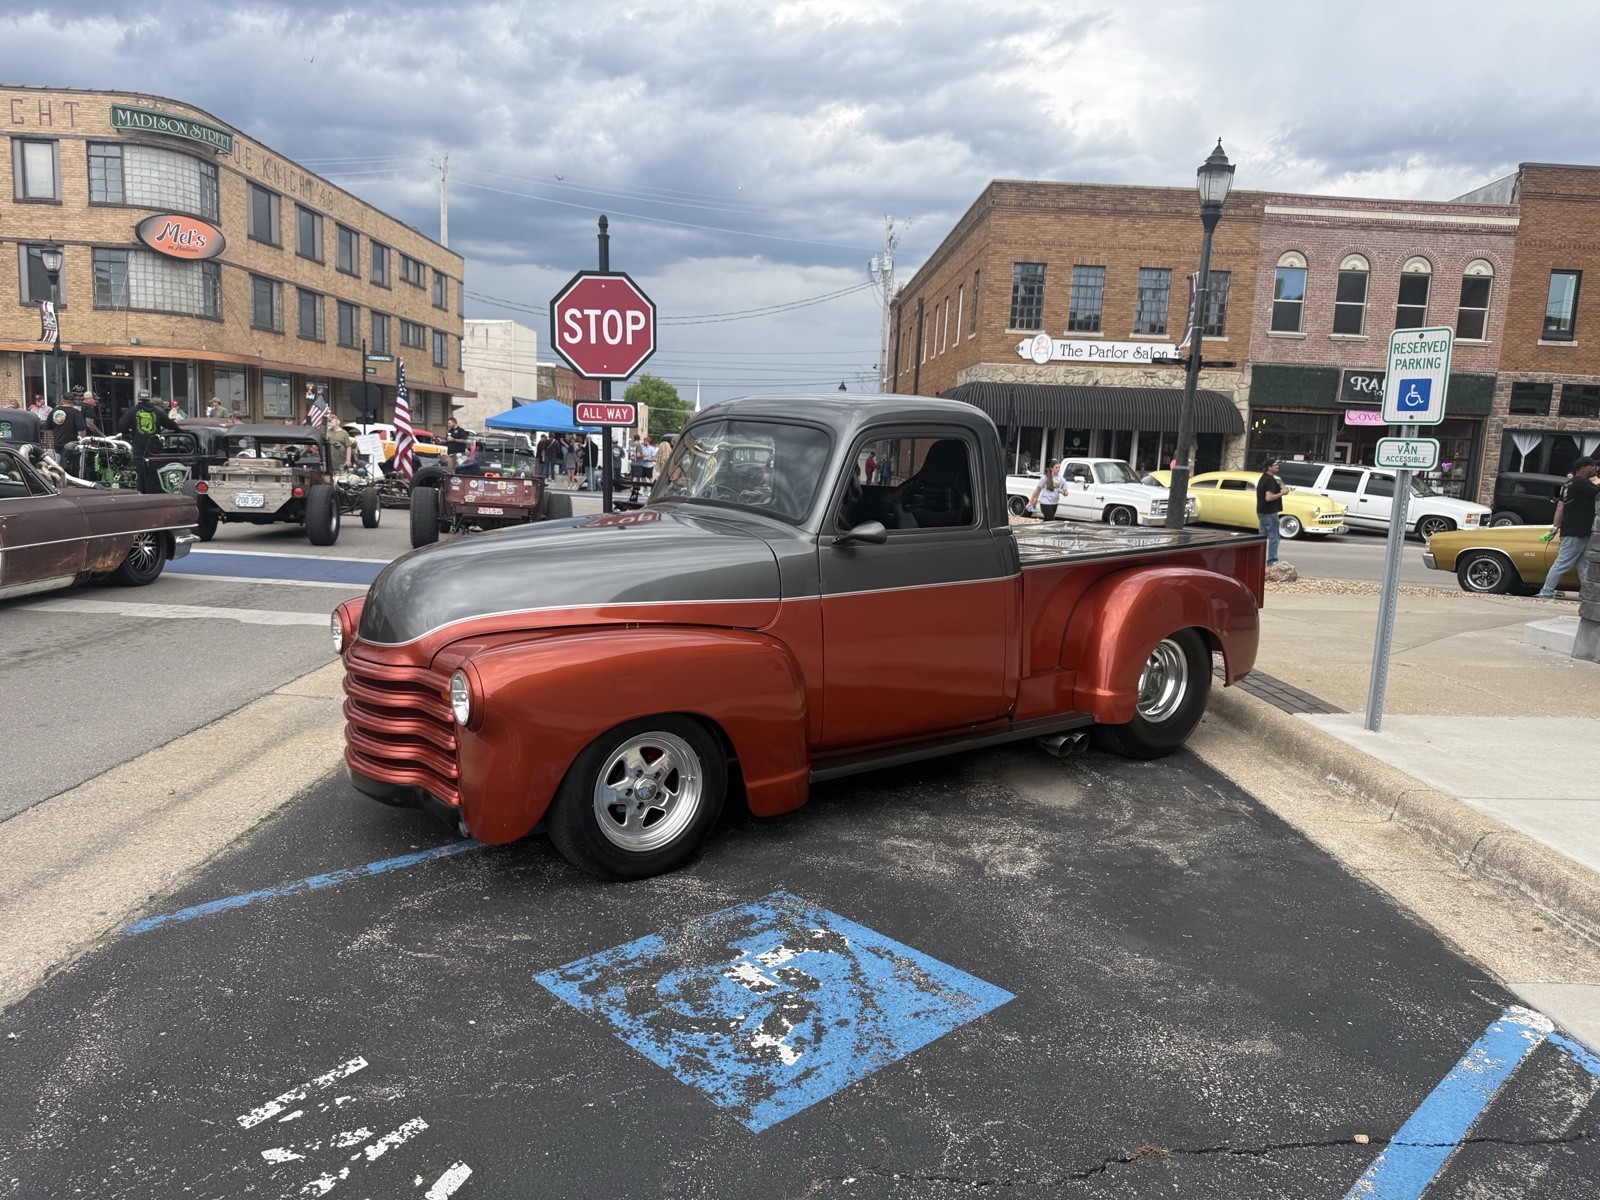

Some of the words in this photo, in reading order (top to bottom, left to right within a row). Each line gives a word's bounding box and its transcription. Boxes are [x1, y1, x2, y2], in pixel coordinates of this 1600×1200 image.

[117, 109, 188, 135] MADISON
[190, 124, 231, 150] STREET
[155, 221, 206, 248] Mel's
[563, 308, 646, 346] STOP
[1060, 343, 1083, 357] The
[1088, 344, 1128, 359] Parlor
[1133, 346, 1168, 359] Salon
[1393, 340, 1447, 355] RESERVED
[1394, 357, 1442, 371] PARKING
[1350, 375, 1384, 393] RA
[583, 407, 603, 419] ALL
[607, 407, 628, 420] WAY
[1397, 445, 1418, 455] VAN
[1385, 455, 1427, 464] ACCESSIBLE
